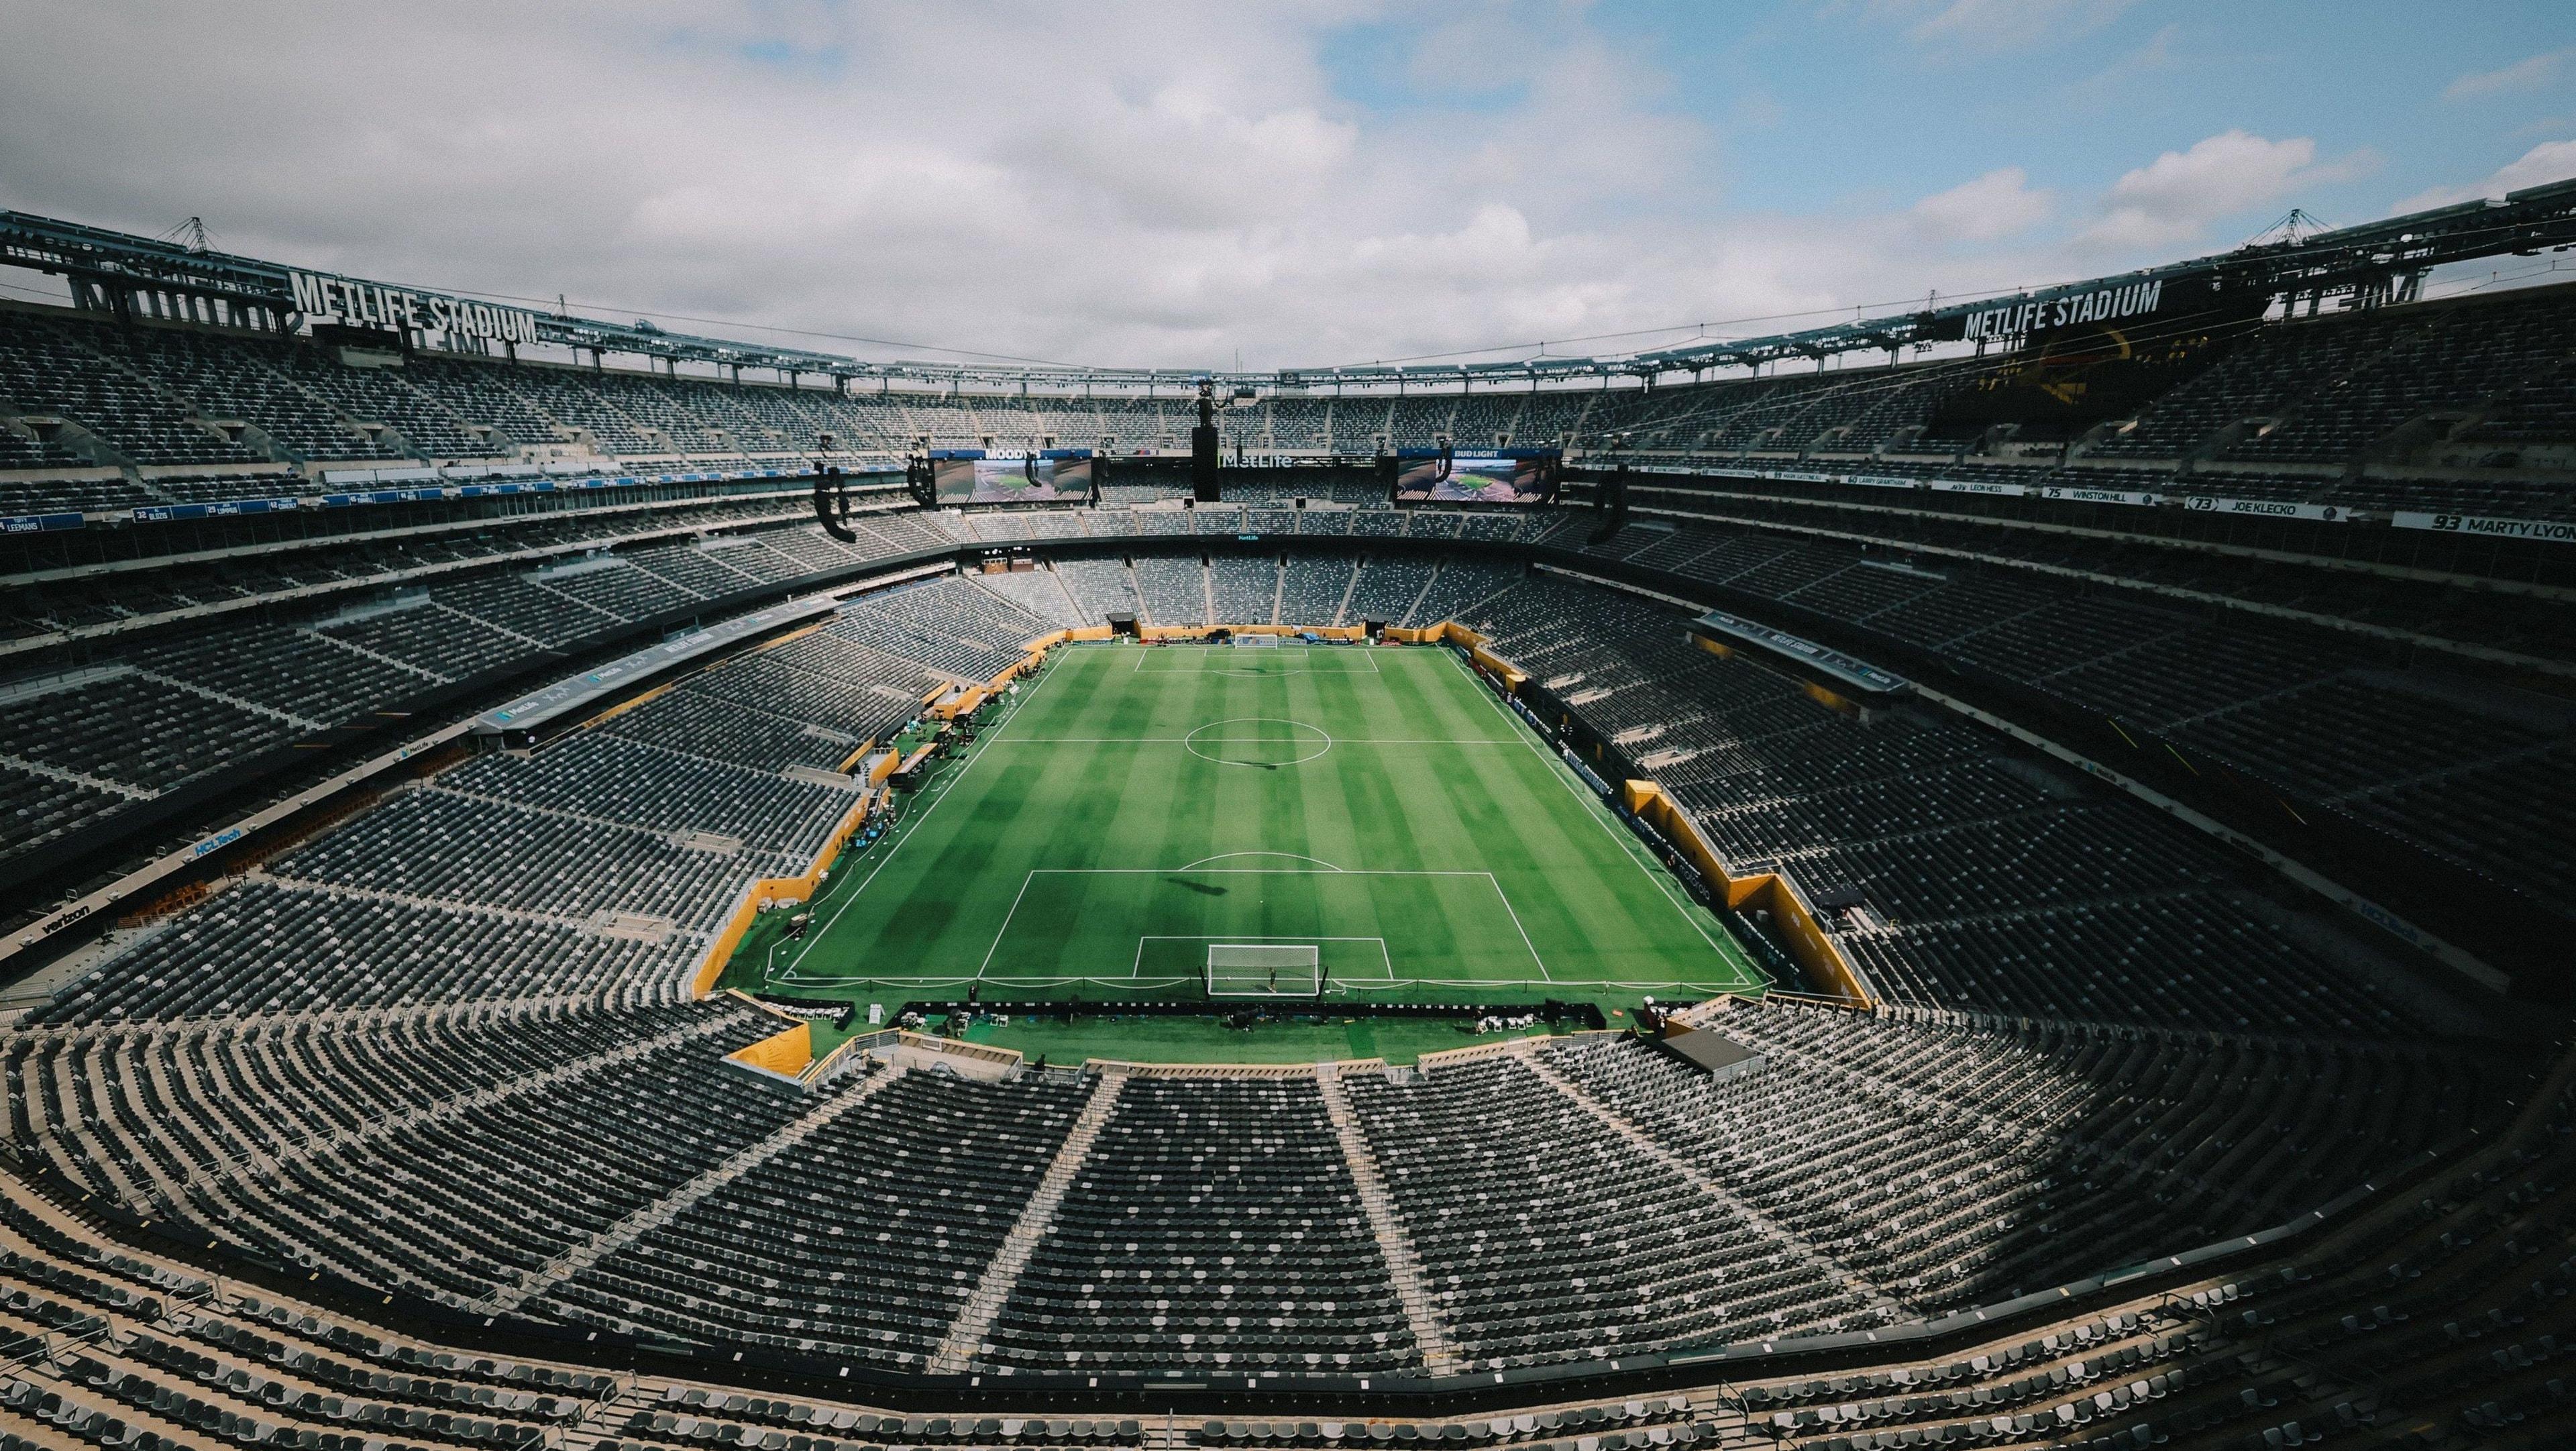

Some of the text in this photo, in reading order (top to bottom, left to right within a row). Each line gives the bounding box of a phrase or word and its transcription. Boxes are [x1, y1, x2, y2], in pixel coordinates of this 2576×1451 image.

[288, 271, 423, 329] METLIFE
[428, 297, 538, 345] STADIUM
[1964, 280, 2163, 339] METLIFE STADIUM
[1222, 452, 1293, 468] MetLife
[1970, 484, 1986, 492] LEON
[1986, 485, 2002, 493] HESS
[2048, 488, 2127, 502] 75 WINSTON HILL
[137, 511, 147, 519] 32
[2195, 498, 2296, 516] 73 JOE KLECKO
[7, 522, 38, 532] LEEMANS
[2431, 515, 2463, 531] 93
[2467, 519, 2531, 535] MARTY
[410, 741, 429, 754] MetLife
[42, 905, 91, 934] verizon
